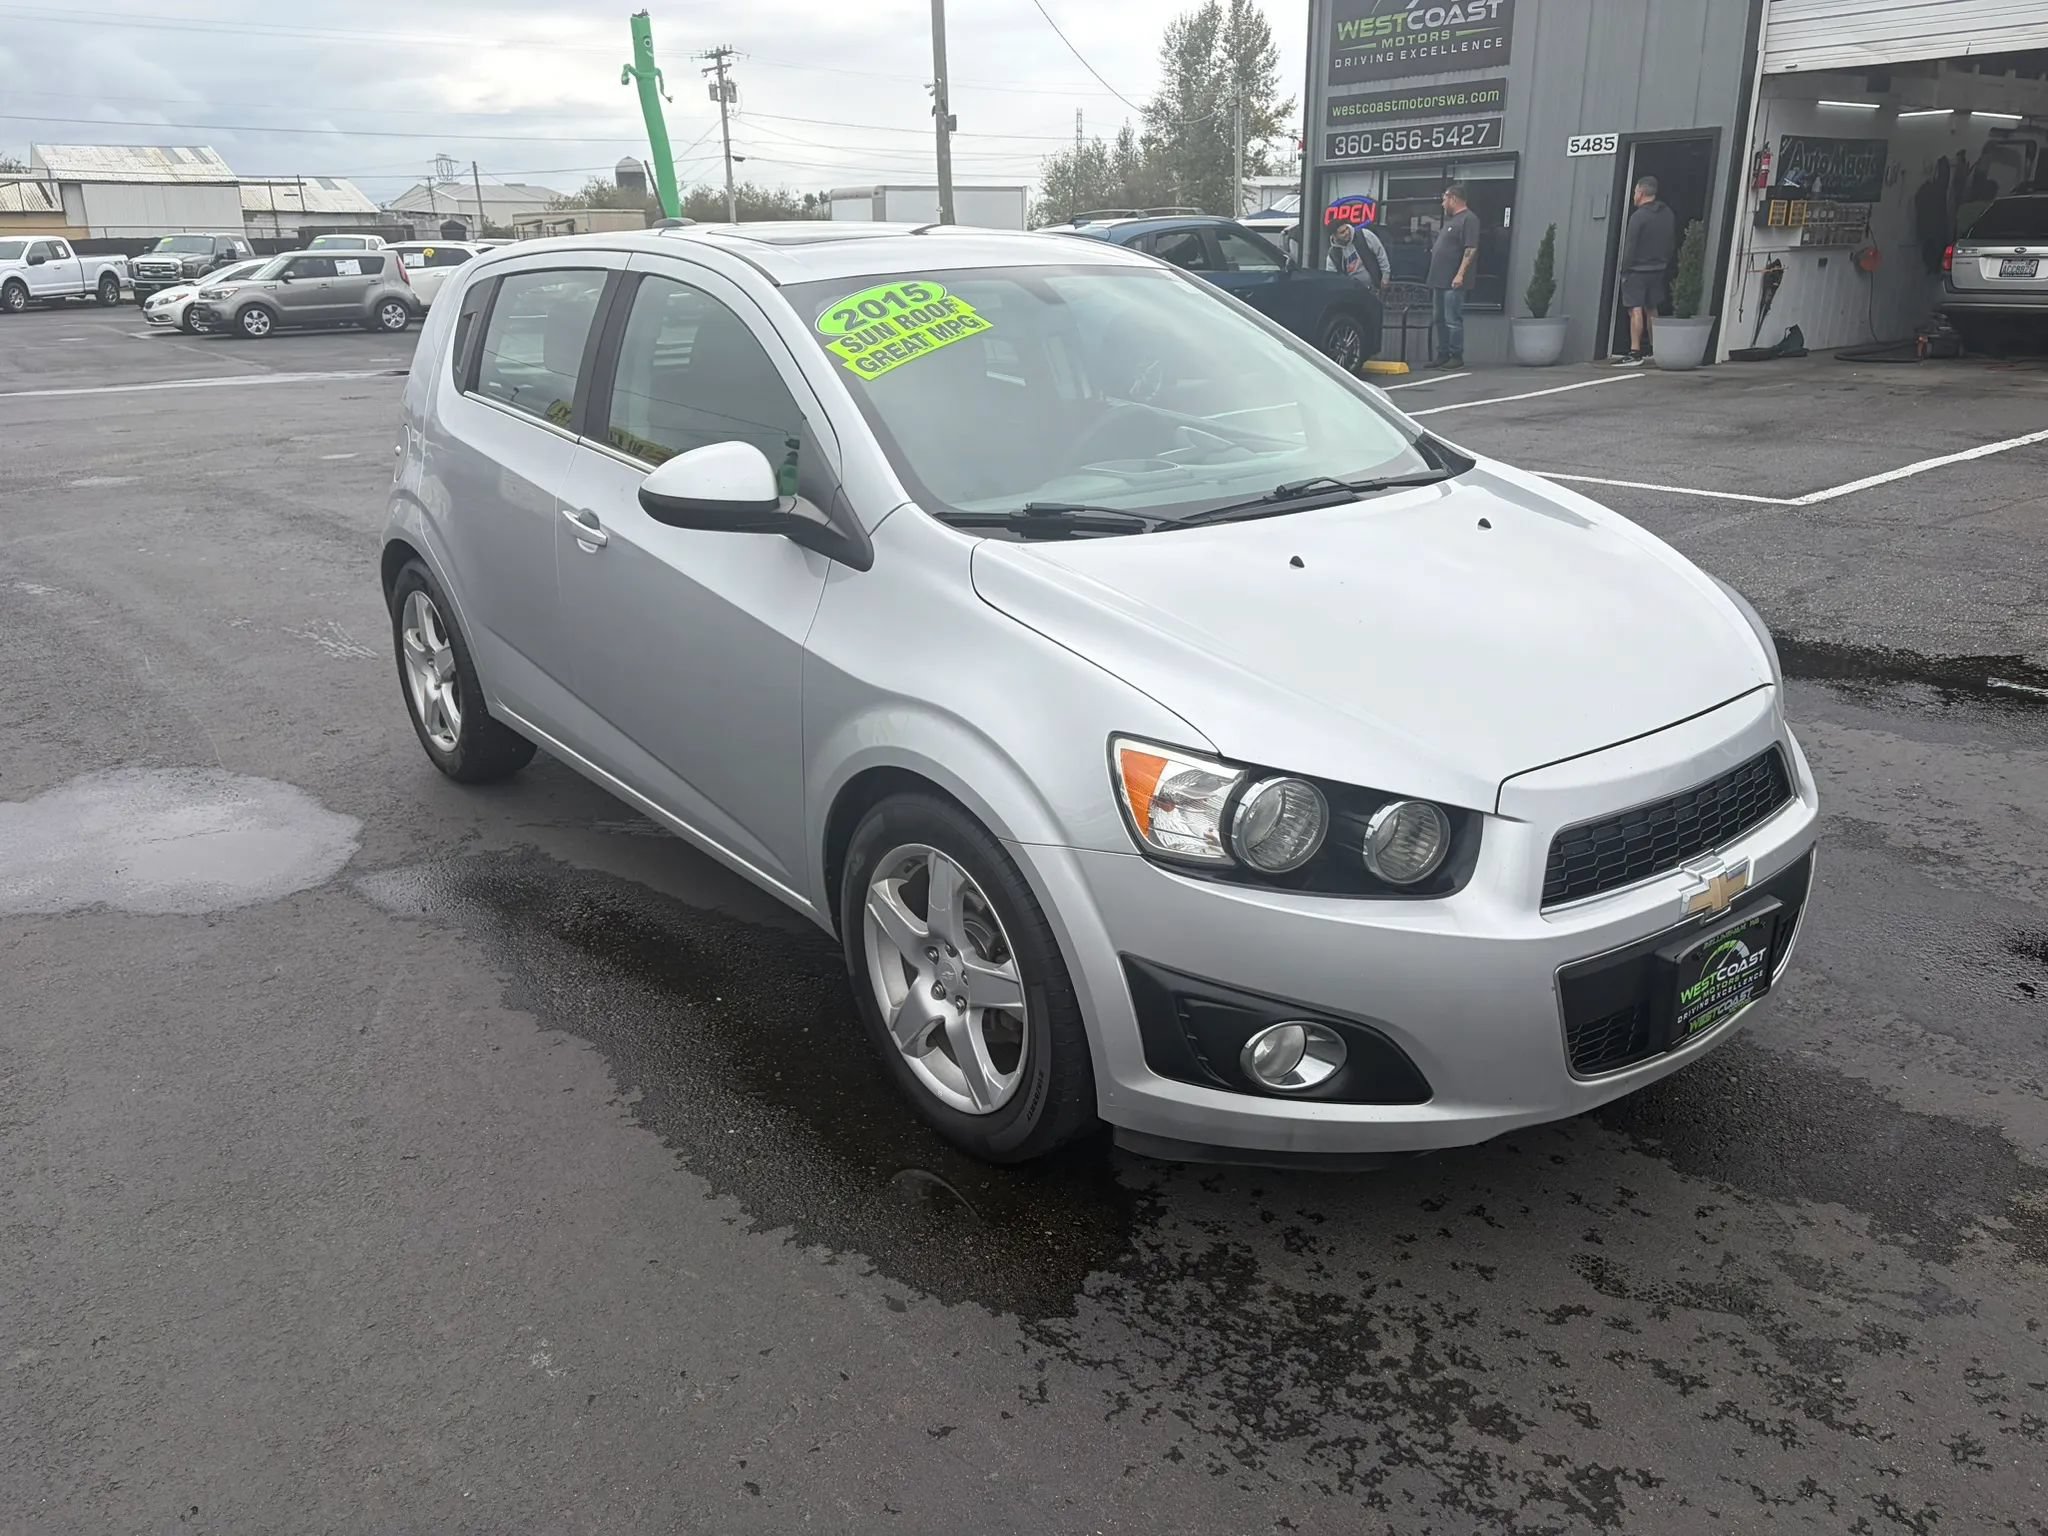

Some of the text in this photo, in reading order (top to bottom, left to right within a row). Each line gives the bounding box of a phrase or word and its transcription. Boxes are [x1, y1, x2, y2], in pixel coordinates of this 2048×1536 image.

[1334, 37, 1504, 68] DRIVING EXCELLENCE
[1381, 30, 1451, 49] MOTORS
[1334, 123, 1491, 156] 360-656-5427
[1570, 137, 1616, 154] 5485
[1324, 203, 1376, 225] OPEN
[832, 283, 933, 332] 2015
[839, 298, 961, 354] SUN ROOF
[855, 314, 986, 373] GREAT MPG
[1677, 998, 1711, 1024] DRIVING
[1710, 969, 1763, 1002] EXCELLENCE
[1702, 974, 1741, 999] MOTORS
